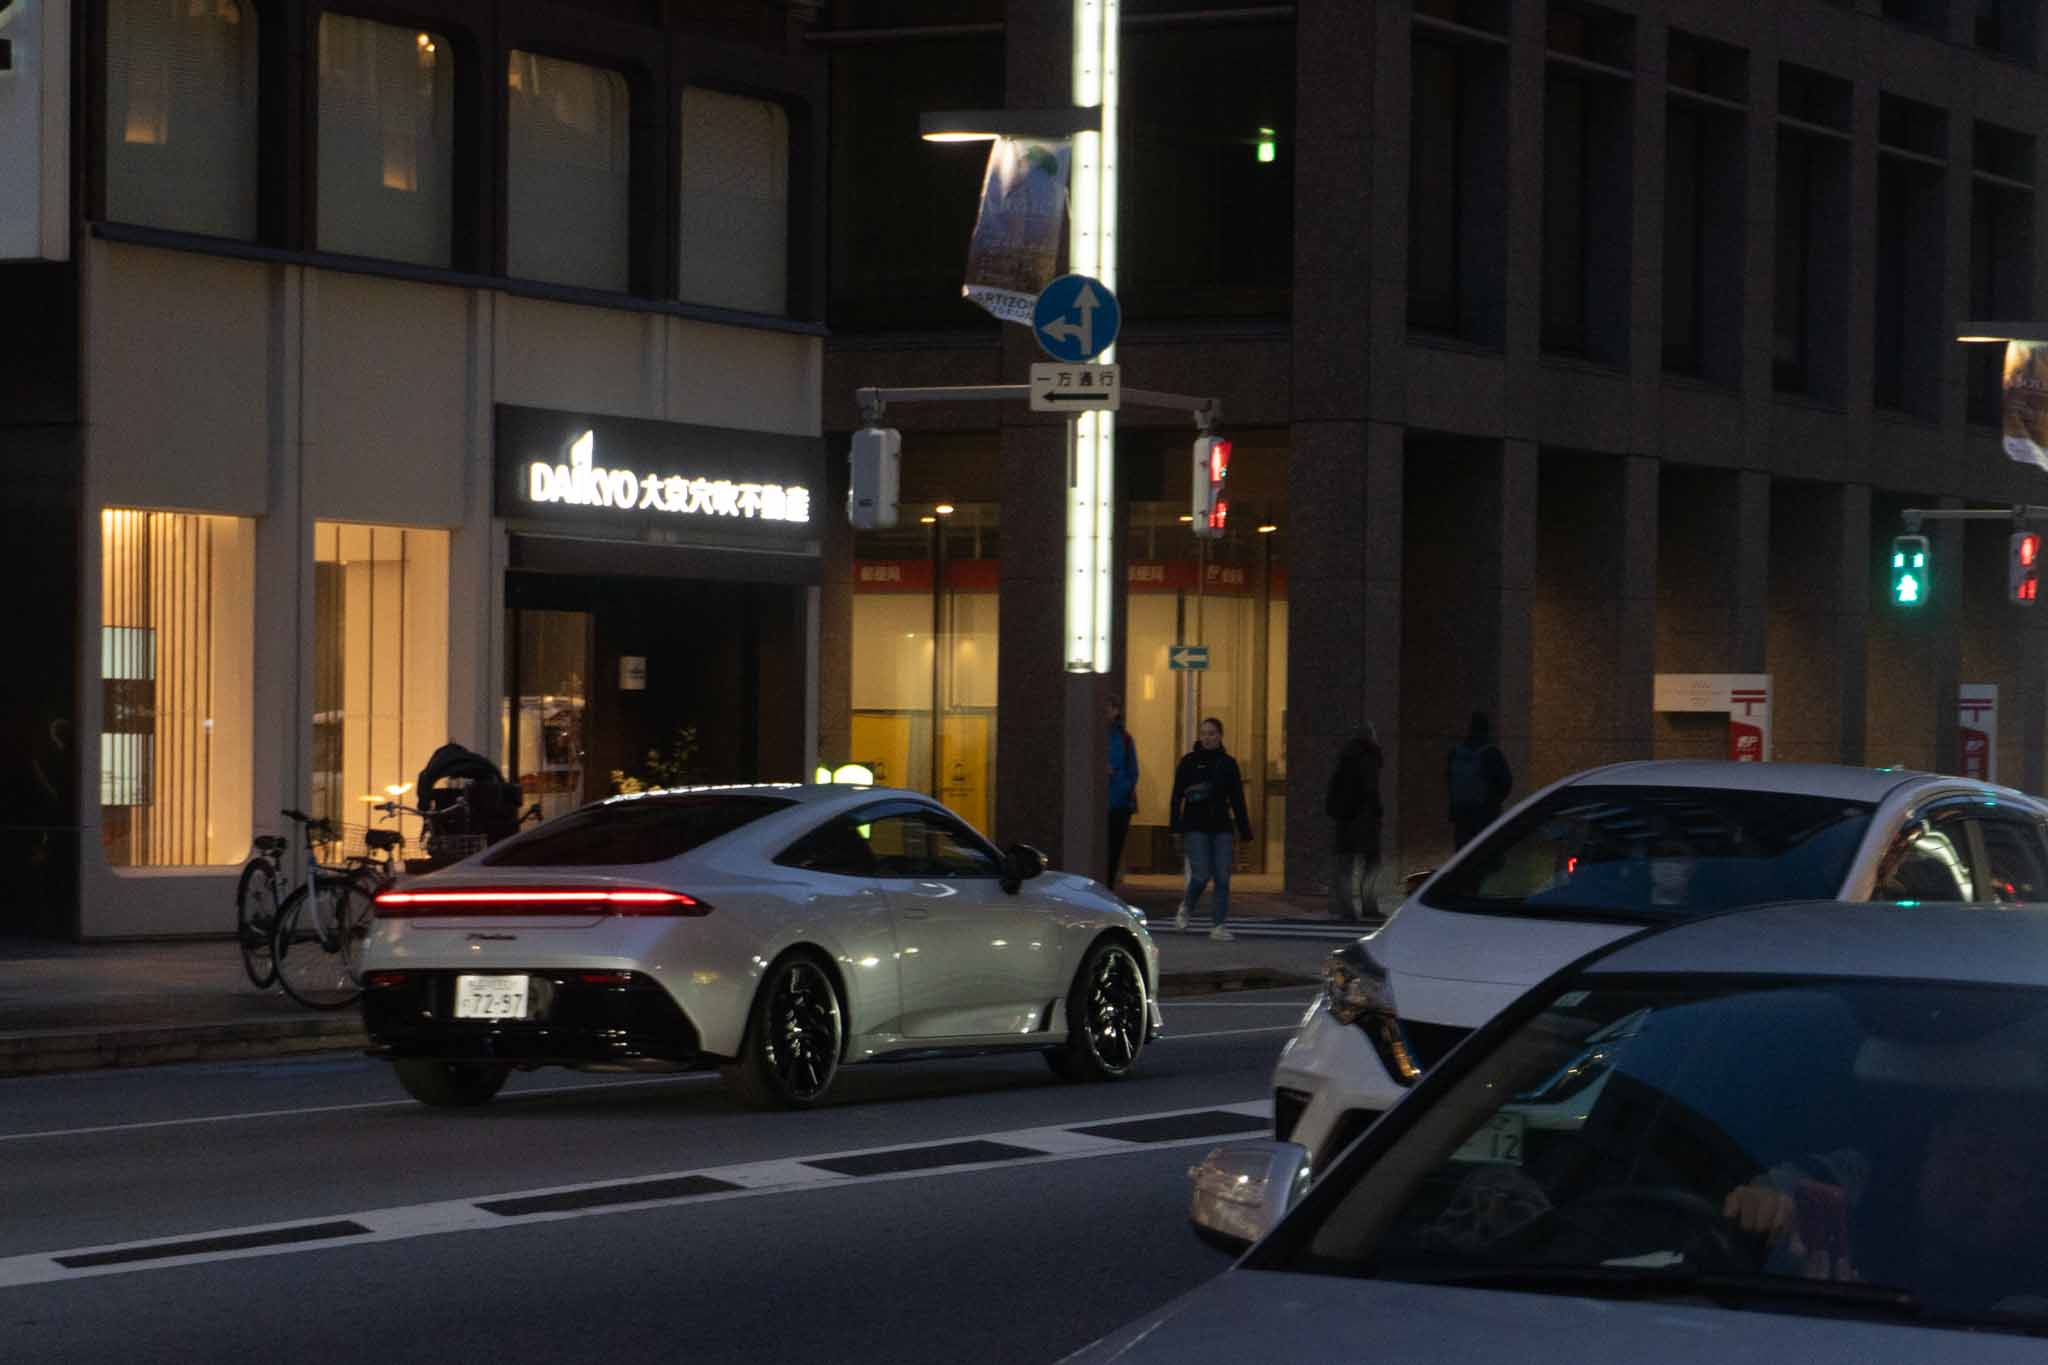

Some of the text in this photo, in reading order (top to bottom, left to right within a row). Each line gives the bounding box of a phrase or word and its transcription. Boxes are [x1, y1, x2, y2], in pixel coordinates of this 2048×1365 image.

[1034, 369, 1114, 387] 一方通行
[529, 430, 810, 522] DAIKYO 大京穴吹不動産
